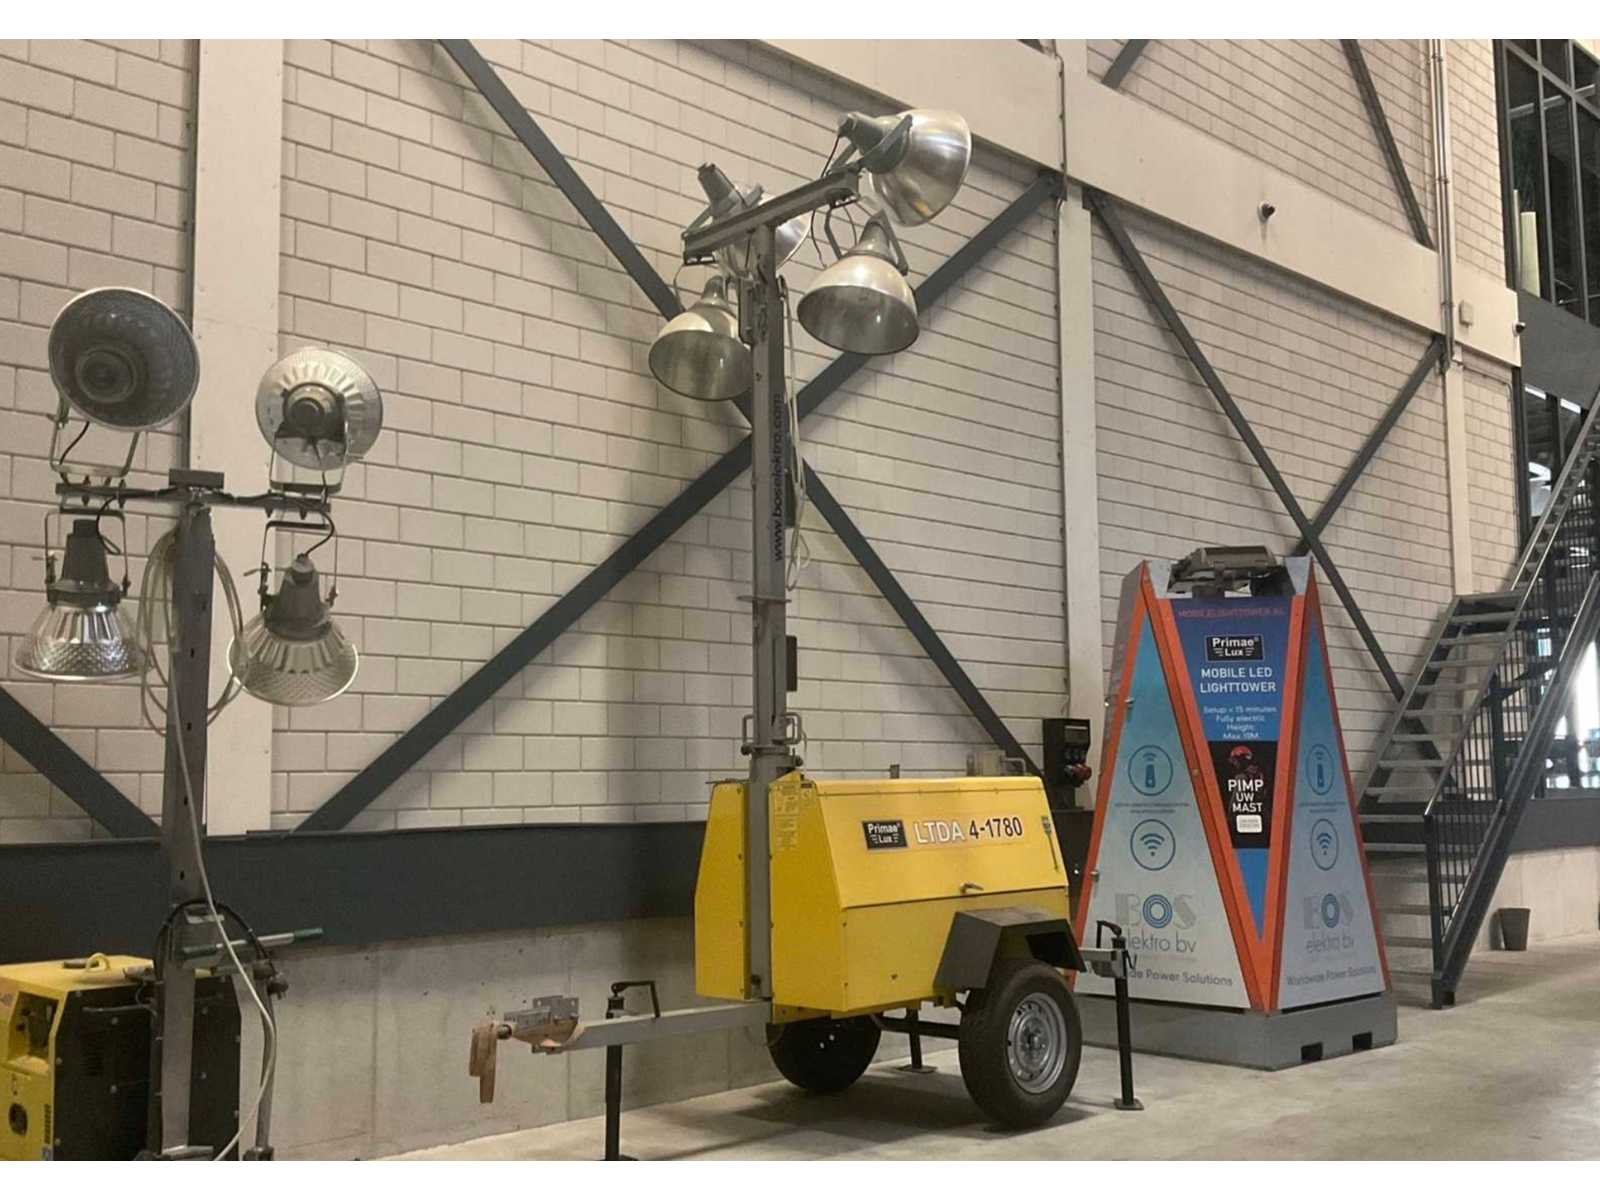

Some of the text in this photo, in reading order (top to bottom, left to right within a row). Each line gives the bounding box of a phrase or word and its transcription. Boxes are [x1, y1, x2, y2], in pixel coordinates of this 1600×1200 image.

[772, 393, 783, 561] www.boselektro.com
[1225, 648, 1243, 656] Lux
[1201, 667, 1272, 679] MOBILE LED
[1200, 682, 1276, 693] LIGHTTOWER
[1228, 779, 1264, 791] PIMP
[1236, 792, 1254, 802] UW
[1232, 802, 1262, 813] MAST
[913, 821, 966, 844] LTDA
[969, 816, 1023, 839] 4-1780
[878, 834, 893, 843] Lux
[1114, 893, 1197, 929] BOS
[1126, 928, 1197, 953] lektro bv
[1146, 969, 1180, 981] Power
[1182, 971, 1233, 986] Solutions
